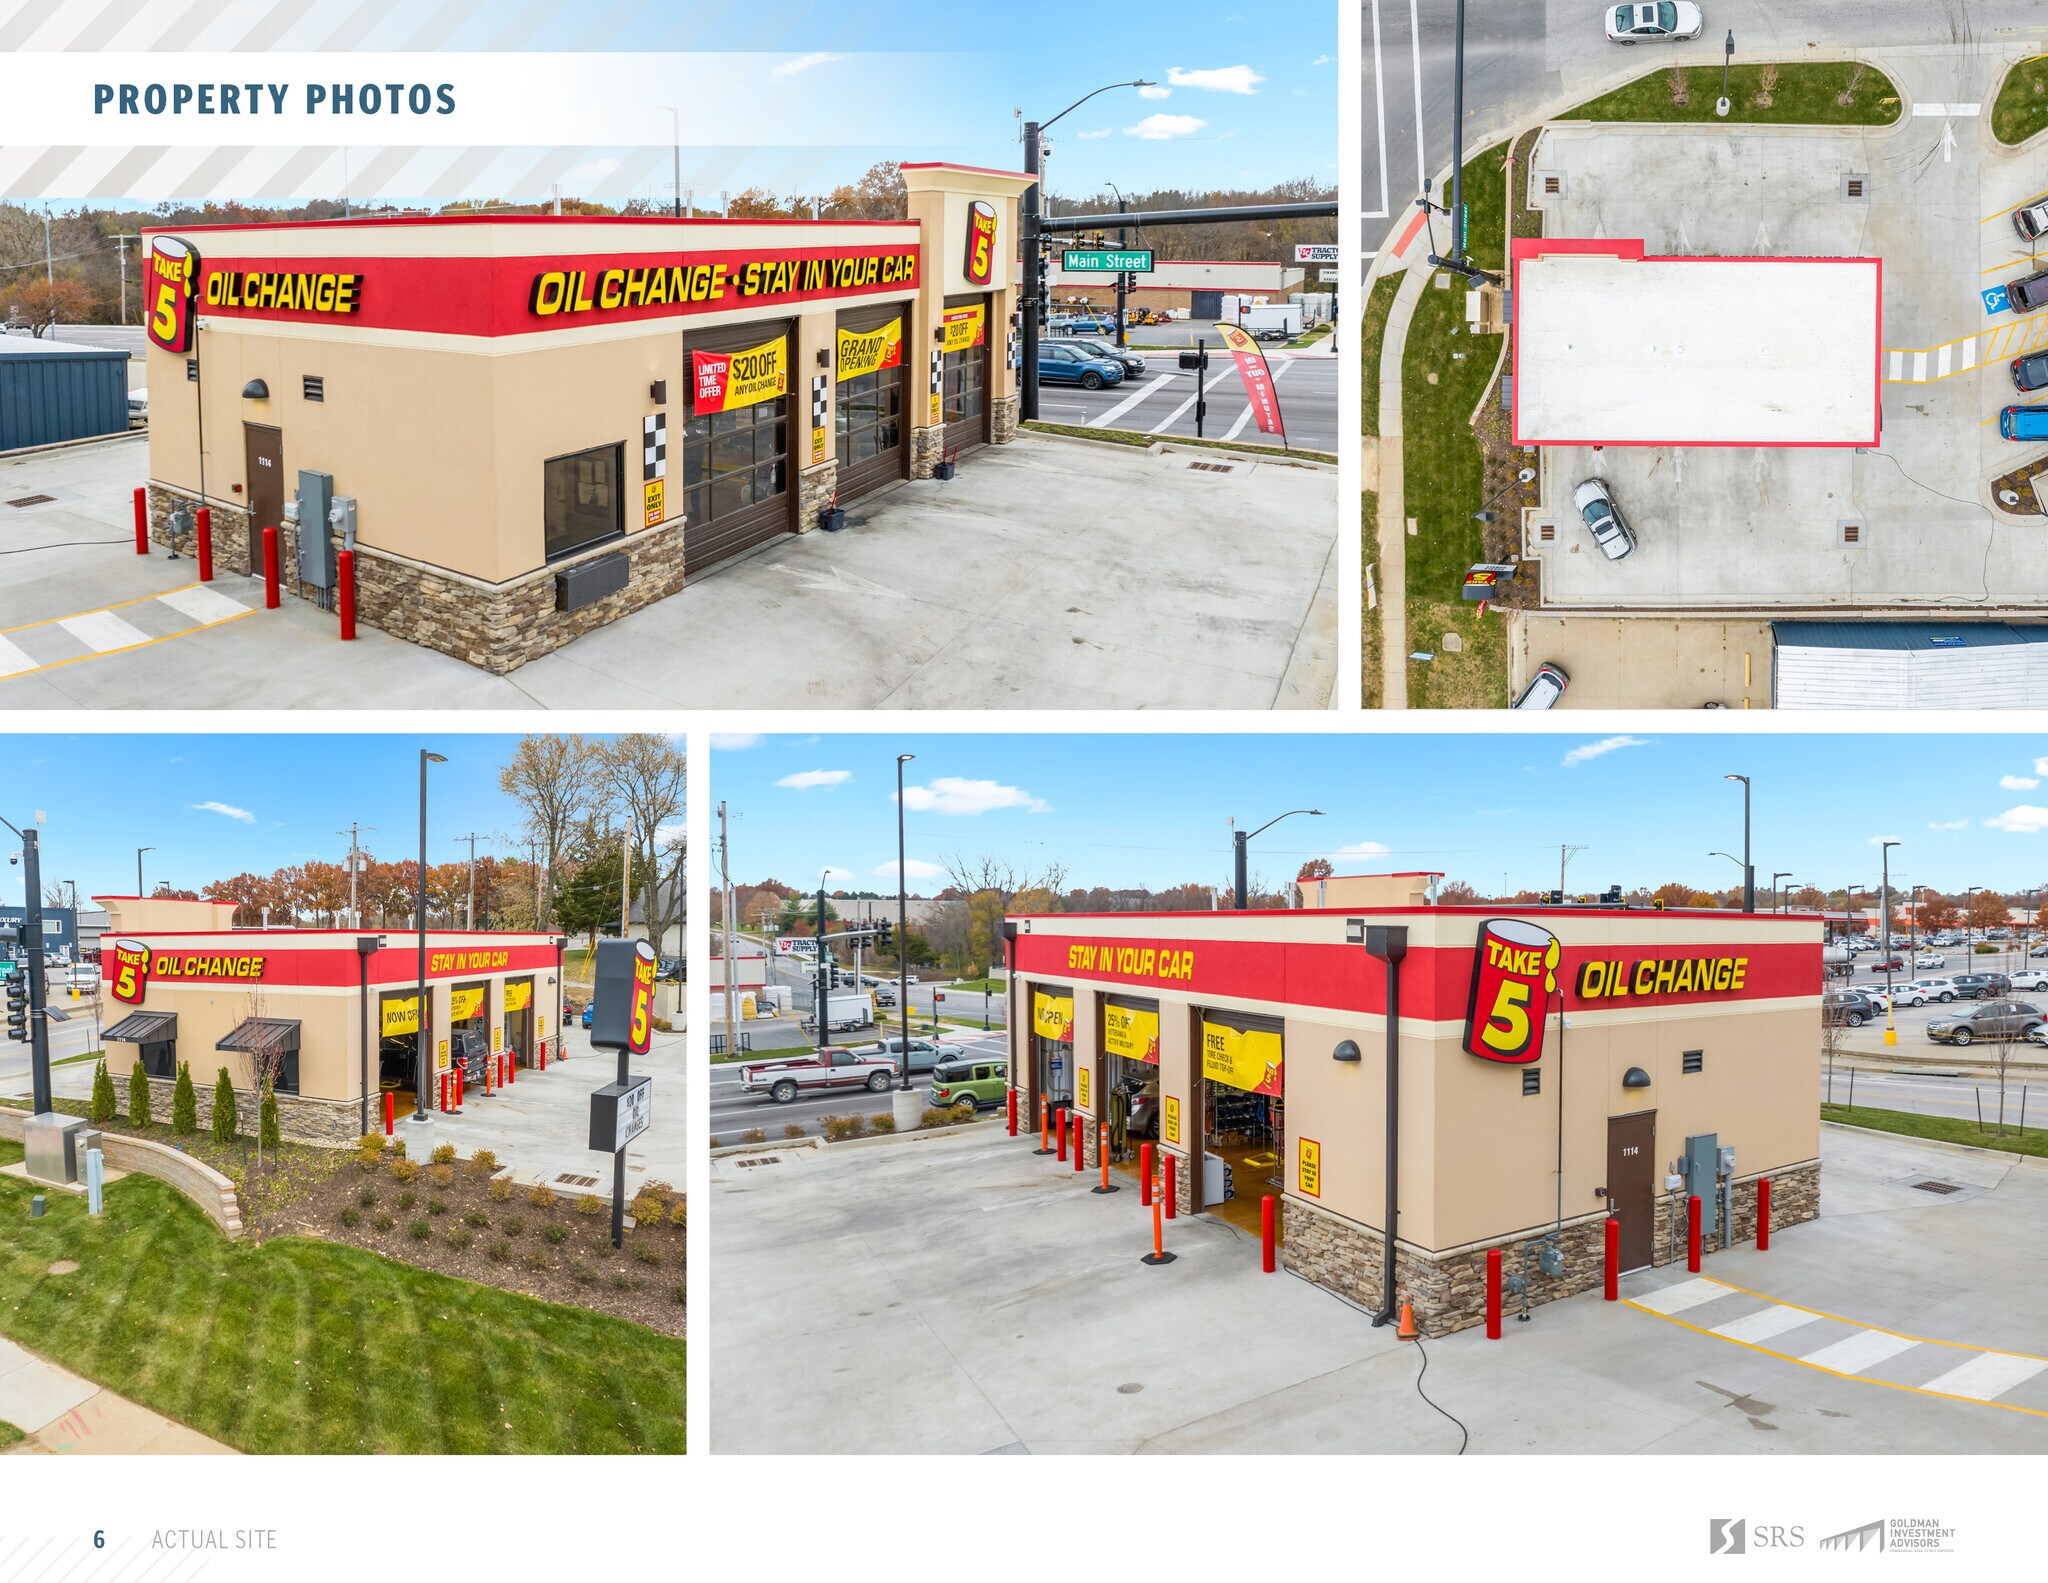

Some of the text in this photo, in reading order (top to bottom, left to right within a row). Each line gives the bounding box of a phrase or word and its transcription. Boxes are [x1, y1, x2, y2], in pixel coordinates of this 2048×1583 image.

[974, 212, 993, 235] TAKE
[972, 234, 989, 278] 5
[1068, 253, 1147, 268] Main Street
[153, 251, 182, 283] TAKE
[207, 271, 358, 313] OIL CHANGE
[533, 254, 915, 316] OIL CHANGE STAY IN YOUR CAR
[152, 284, 177, 341] 5
[840, 336, 884, 358] GRAND
[698, 362, 727, 376] LIMITED
[732, 350, 777, 382] $20 OFF
[840, 353, 878, 373] OPENING
[699, 374, 717, 387] TIME
[734, 376, 777, 396] ANY OIL CHANGE
[699, 385, 721, 399] OFFER
[258, 456, 272, 468] 1114
[646, 500, 662, 511] ONLY
[647, 492, 661, 503] EXIT
[116, 948, 141, 966] TAKE
[156, 956, 265, 977] OIL CHANGE
[431, 951, 509, 972] STAY IN YOUR CAR
[1068, 944, 1195, 981] STAY IN YOUR CAR
[1486, 938, 1543, 977] TAKE
[635, 956, 652, 985] TAKE
[1580, 956, 1749, 999] OIL CHANGE
[115, 966, 137, 998] 5
[386, 1010, 406, 1024] NOW
[632, 988, 648, 1045] 5
[1480, 978, 1531, 1052] 5
[1206, 1033, 1225, 1051] FREE
[1206, 1049, 1216, 1060] TIRE
[1216, 1051, 1230, 1064] CHECK
[1206, 1059, 1219, 1070] FLUID
[1622, 1146, 1639, 1157] 1114
[1302, 1160, 1317, 1169] PLEASE
[1304, 1181, 1314, 1189] CAR
